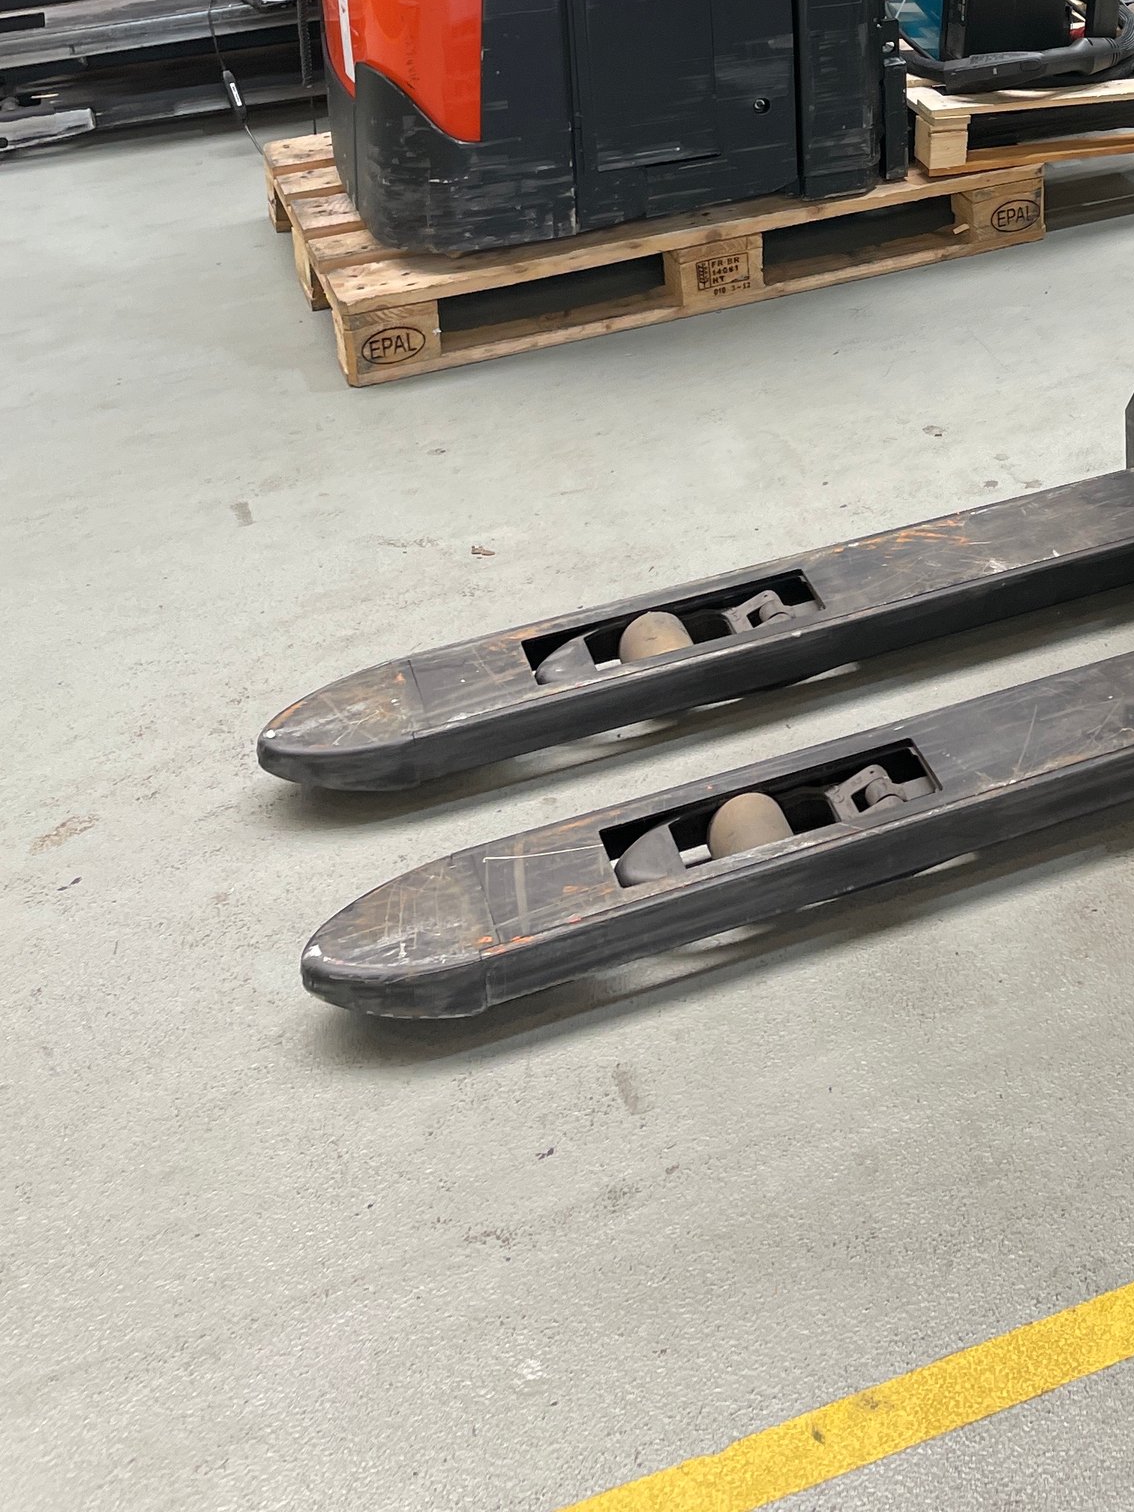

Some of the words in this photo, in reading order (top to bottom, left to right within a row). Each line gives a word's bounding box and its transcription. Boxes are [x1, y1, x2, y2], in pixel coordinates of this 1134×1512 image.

[997, 205, 1033, 228] EPAL
[712, 275, 726, 285] HT
[369, 331, 418, 359] EPAL
